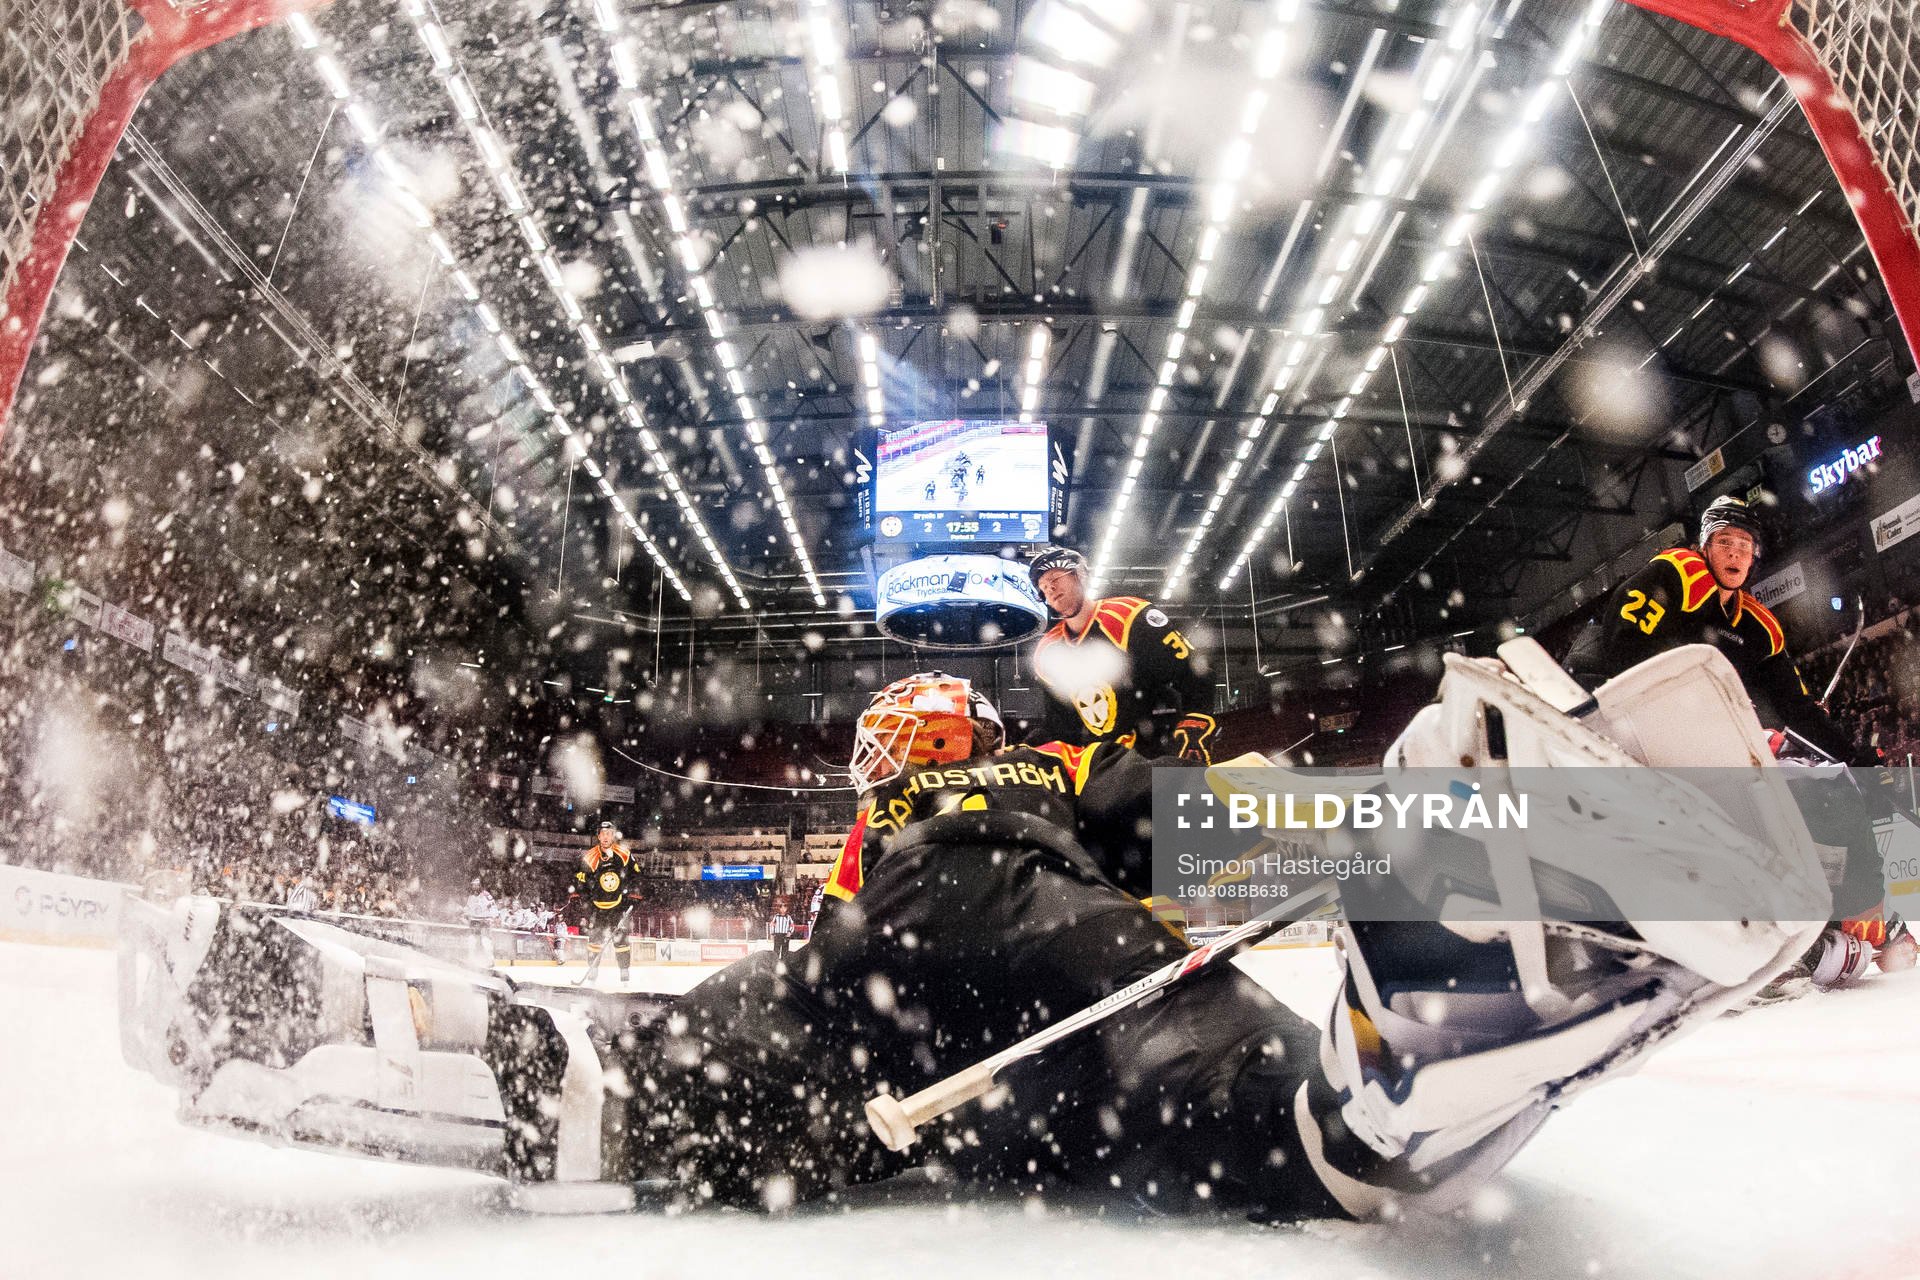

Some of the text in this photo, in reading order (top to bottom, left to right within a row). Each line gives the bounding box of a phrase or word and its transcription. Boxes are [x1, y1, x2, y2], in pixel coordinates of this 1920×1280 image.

[1808, 436, 1881, 494] Skybar
[924, 521, 933, 533] 2
[946, 521, 979, 533] 17:55
[992, 521, 1001, 533] 2
[1755, 576, 1801, 602] Bilmetro
[1620, 590, 1666, 635] 23
[1162, 630, 1195, 660] 3
[1190, 936, 1218, 946] Cave
